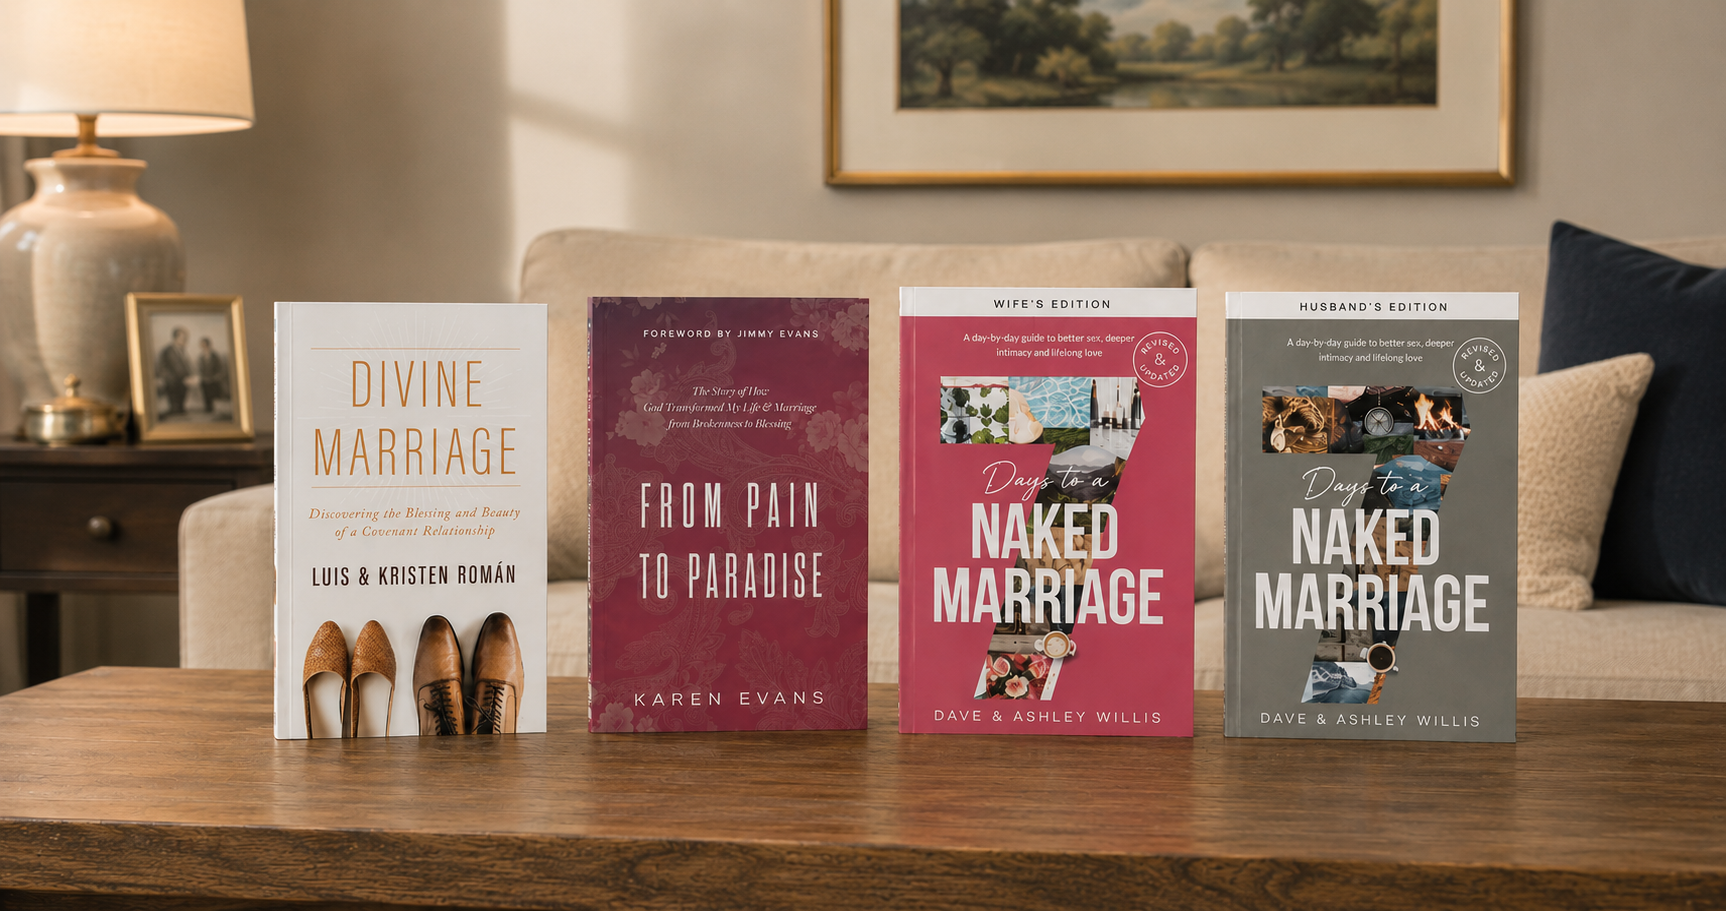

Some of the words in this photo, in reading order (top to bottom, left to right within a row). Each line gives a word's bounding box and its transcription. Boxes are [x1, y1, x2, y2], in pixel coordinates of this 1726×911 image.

[994, 299, 1044, 309] WIFE'S
[1051, 299, 1111, 309] EDITION
[1299, 302, 1382, 312] HUSBAND'S
[1389, 302, 1448, 312] EDITION
[643, 329, 711, 338] FOREWORD
[717, 329, 731, 338] BY
[737, 329, 773, 338] JIMMY
[779, 329, 819, 338] EVANS
[963, 333, 971, 342] A
[972, 333, 1020, 344] day-by-day
[1021, 333, 1045, 344] guide
[1047, 334, 1057, 342] to
[1057, 333, 1084, 342] better
[1086, 335, 1104, 343] sex,
[1105, 333, 1135, 344] deeper
[1140, 338, 1180, 355] REVISED
[1287, 338, 1294, 347] A
[1295, 338, 1342, 349] day-by-day
[1344, 338, 1367, 349] guide
[1368, 339, 1378, 347] to
[1379, 338, 1405, 347] better
[1406, 340, 1424, 348] sex,
[1425, 338, 1455, 349] deeper
[996, 348, 1032, 358] intimacy
[1033, 348, 1049, 357] and
[1051, 348, 1083, 358] lifelong
[1085, 348, 1103, 357] love
[1154, 353, 1166, 365] &
[1319, 352, 1353, 363] intimacy
[1355, 353, 1371, 362] and
[1373, 353, 1404, 363] lifelong
[1405, 353, 1423, 362] love
[1461, 345, 1500, 362] REVISED
[1139, 364, 1180, 381] UPDATED
[1474, 359, 1485, 372] &
[352, 360, 482, 408] DIVINE
[1459, 370, 1499, 388] UPDATED
[692, 386, 710, 396] The
[737, 386, 748, 398] of
[643, 403, 663, 412] God
[665, 402, 725, 414] Transformed
[726, 403, 741, 414] My
[743, 402, 761, 414] Life
[762, 403, 772, 412] &
[774, 402, 817, 414] Marriage
[666, 419, 690, 430] from
[692, 419, 744, 428] Brokenness
[744, 420, 753, 428] to
[755, 419, 792, 430] Blessing
[315, 427, 516, 476] MARRIAGE
[982, 460, 1054, 501] Days
[1056, 466, 1085, 488] to
[1092, 477, 1110, 488] a
[1301, 466, 1374, 507] Days
[1376, 471, 1403, 495] to
[1411, 482, 1429, 494] a
[641, 482, 721, 528] FROM
[747, 482, 818, 528] PAIN
[309, 507, 380, 522] Discovering
[383, 508, 401, 519] the
[405, 507, 451, 521] Blessing
[455, 507, 476, 518] and
[482, 506, 521, 520] Beauty
[335, 526, 349, 540] of
[350, 529, 357, 537] a
[362, 526, 418, 537] Covenant
[422, 525, 496, 539] Relationship
[972, 503, 1118, 559] NAKED
[1292, 507, 1440, 565] NAKED
[312, 567, 349, 586] LUIS
[359, 566, 369, 586] &
[379, 565, 448, 585] KRISTEN
[458, 561, 516, 584] ROMÁN
[639, 552, 668, 599] TO
[688, 552, 822, 598] PARADISE
[933, 567, 1164, 625] MARRIAGE
[1255, 572, 1490, 632] MARRIAGE
[634, 692, 721, 706] KAREN
[739, 691, 824, 705] EVANS
[934, 710, 981, 722] DAVE
[992, 710, 1002, 722] &
[1013, 711, 1085, 723] ASHLEY
[1097, 712, 1162, 724] WILLIS
[1260, 712, 1306, 724] DAVE
[1316, 713, 1327, 725] &
[1336, 714, 1406, 726] ASHLEY
[1417, 715, 1480, 727] WILLIS
